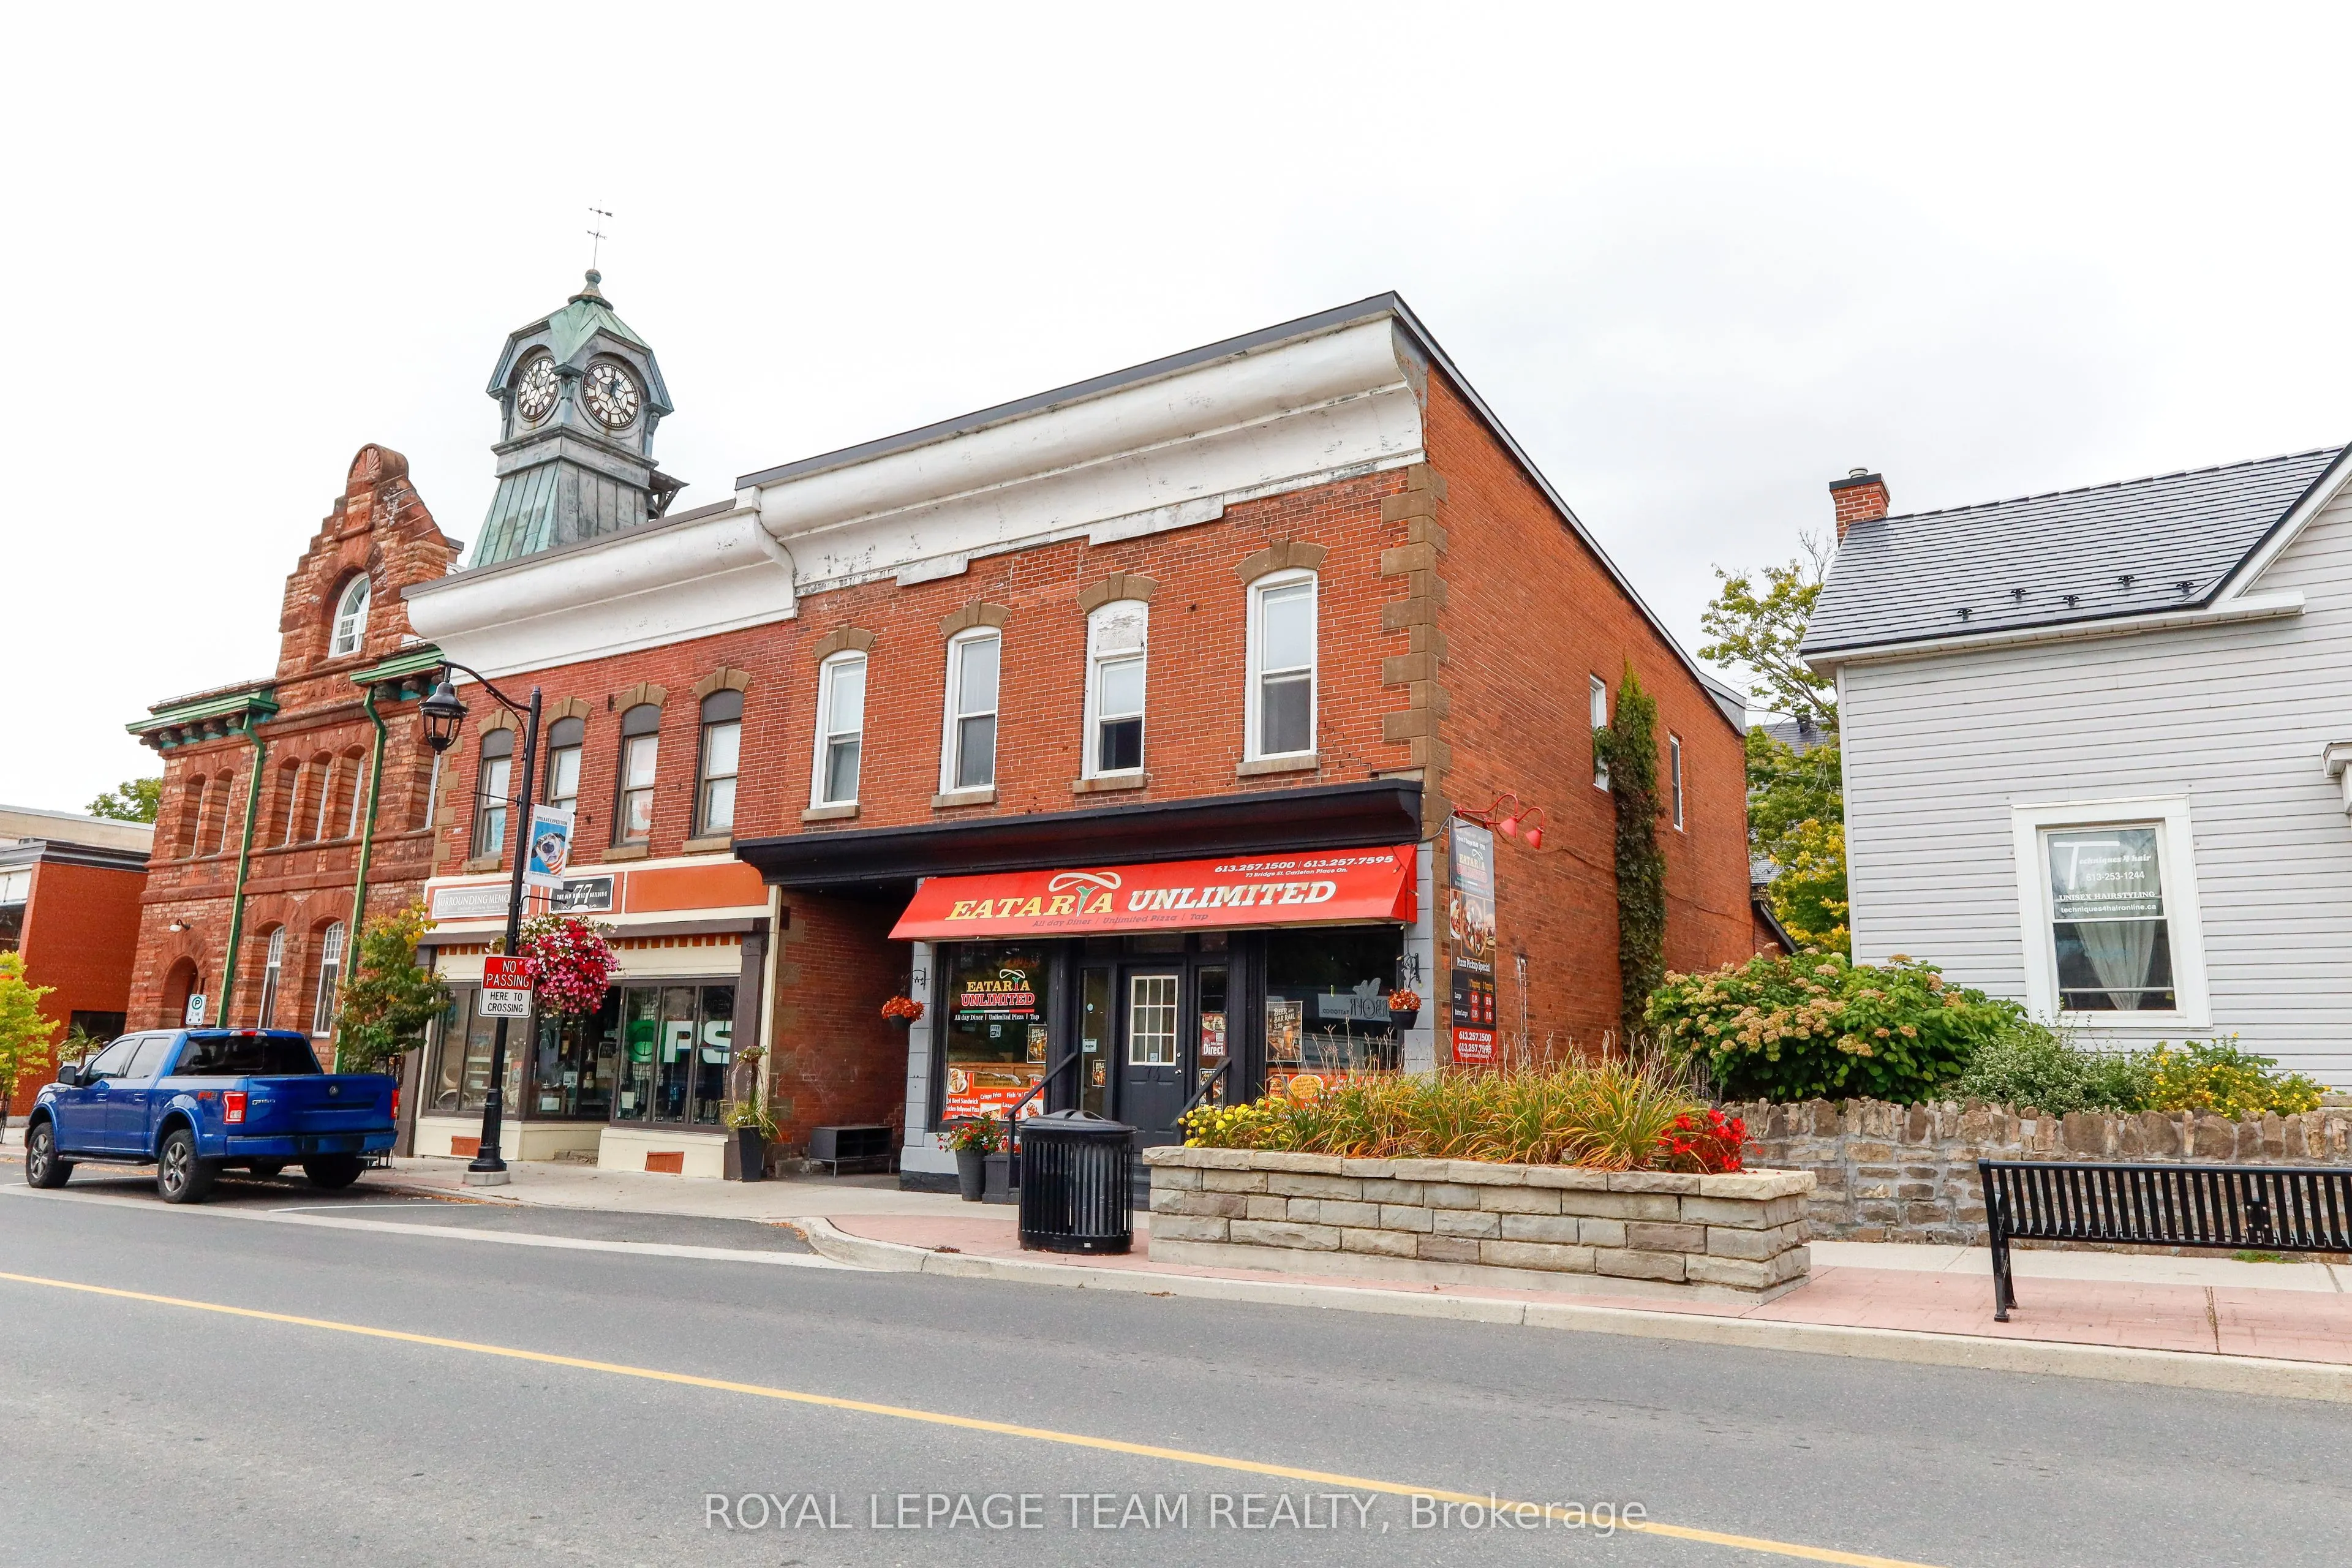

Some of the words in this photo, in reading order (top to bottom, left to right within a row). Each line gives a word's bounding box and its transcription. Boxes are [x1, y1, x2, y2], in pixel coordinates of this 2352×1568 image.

[1215, 861, 1295, 873] 613.257.1500
[1303, 855, 1394, 869] 613.257.7595
[2132, 854, 2152, 862] hair
[2086, 871, 2145, 881] 613-253-1244
[437, 894, 488, 907] SURROUNDING
[489, 892, 526, 903] MEMOS
[573, 883, 594, 905] 77
[1128, 880, 1337, 911] UNLIMITED
[2094, 891, 2155, 900] HAIRSTYLING
[2060, 904, 2157, 913] techniques4haironline.ca
[1047, 919, 1065, 928] day
[1103, 916, 1148, 925] Unlimited
[502, 960, 516, 973] NO
[1457, 957, 1467, 968] Pizza
[1467, 959, 1479, 971] Pickup
[1478, 961, 1490, 973] Special
[486, 973, 530, 987] PASSING
[490, 992, 509, 1001] HERE
[514, 992, 522, 1001] TO
[961, 992, 1035, 1007] UNLIMITED
[488, 1003, 523, 1012] CROSSING
[1273, 1008, 1287, 1017] BEER
[1284, 1012, 1295, 1022] RAIL
[1458, 1030, 1491, 1042] 613.257.1500
[1203, 1043, 1224, 1055] Direct
